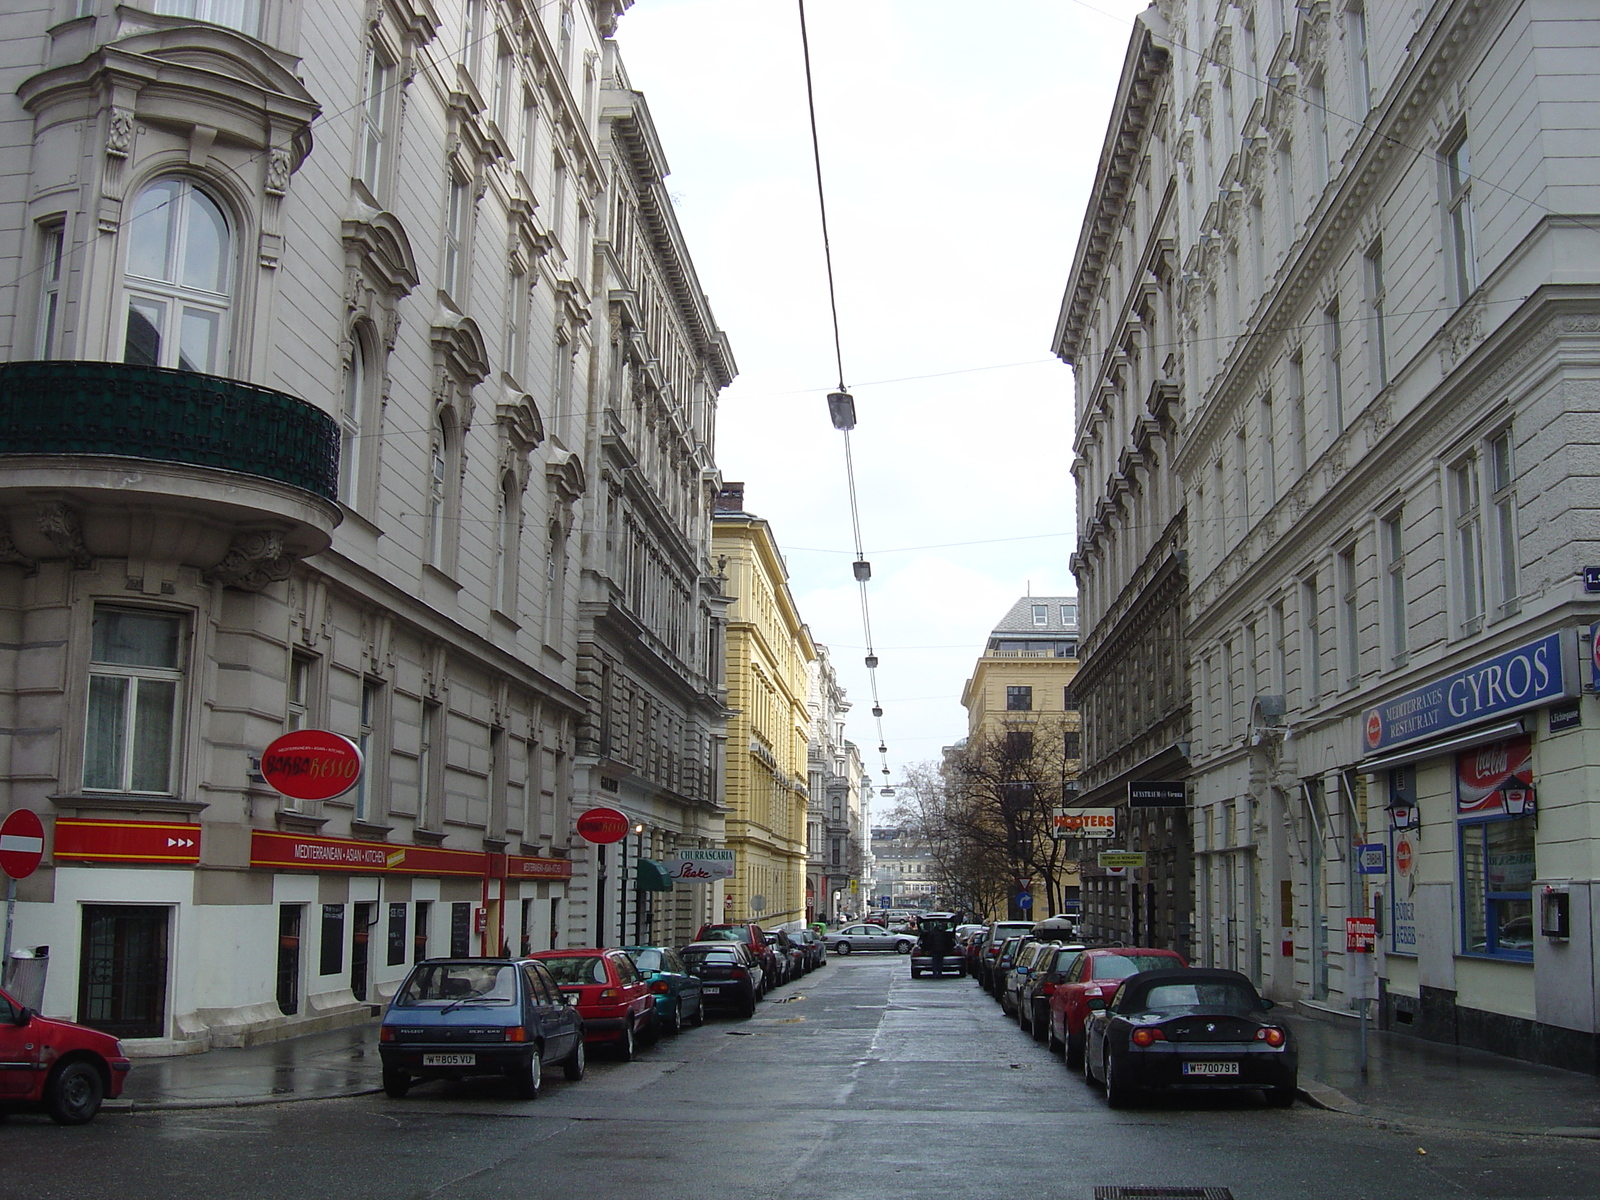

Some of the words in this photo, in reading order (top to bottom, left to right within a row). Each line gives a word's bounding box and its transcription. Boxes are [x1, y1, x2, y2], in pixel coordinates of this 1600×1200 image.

[1448, 642, 1549, 718] GYROS
[1385, 688, 1443, 723] MEDITERRANES
[1389, 709, 1439, 738] RESTAURANT
[1053, 815, 1115, 829] HOOTERS
[294, 844, 342, 861] MEDITERRANEAN
[345, 848, 362, 862] ASIAN
[364, 850, 386, 863] KITCHEN
[680, 850, 733, 860] CHURRASCARIA
[428, 1056, 434, 1064] W
[441, 1056, 458, 1064] 805
[460, 1056, 471, 1064] VU
[1189, 1064, 1196, 1073] W
[1203, 1064, 1229, 1073] 70079
[1231, 1064, 1237, 1073] R
